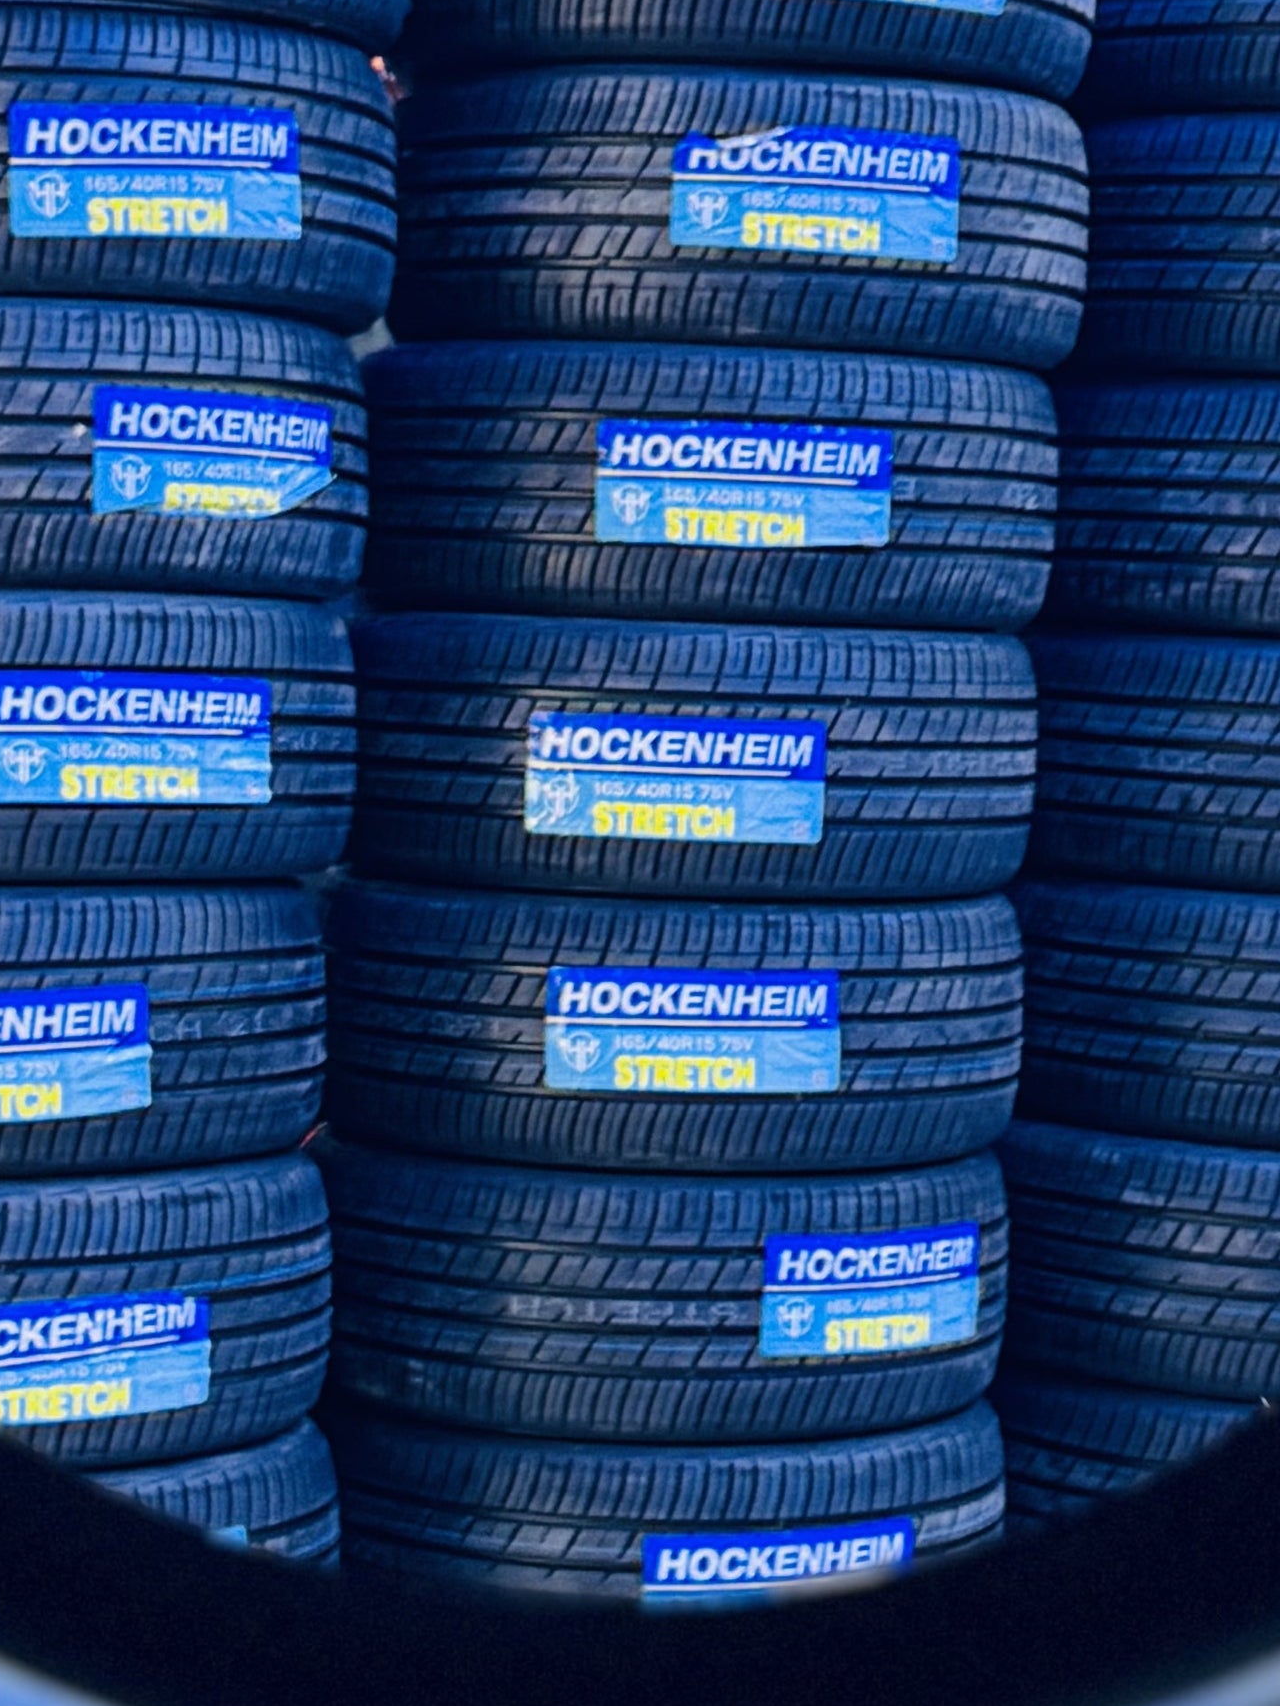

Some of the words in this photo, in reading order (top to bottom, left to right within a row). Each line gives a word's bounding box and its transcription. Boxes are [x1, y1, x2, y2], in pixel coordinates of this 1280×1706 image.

[25, 118, 288, 159] HOCKENHEIM
[86, 197, 228, 234] STRETCH
[741, 213, 881, 250] STRETCH
[109, 401, 328, 452] HOCKENHEIM
[611, 433, 881, 476] HOCKENHEIM
[665, 507, 805, 545] STRETCH
[0, 686, 261, 724] HOCKENHEIM
[539, 725, 815, 767] HOCKENHEIM
[60, 765, 200, 801] STRETCH
[593, 801, 734, 838] STRETCH
[558, 981, 827, 1017] HOCKENHEIM
[614, 1056, 755, 1090] STRETCH
[777, 1236, 974, 1281] HOCKENHEIM
[824, 1314, 930, 1353] STRETCH
[656, 1532, 904, 1581] HOCKENHEIM
